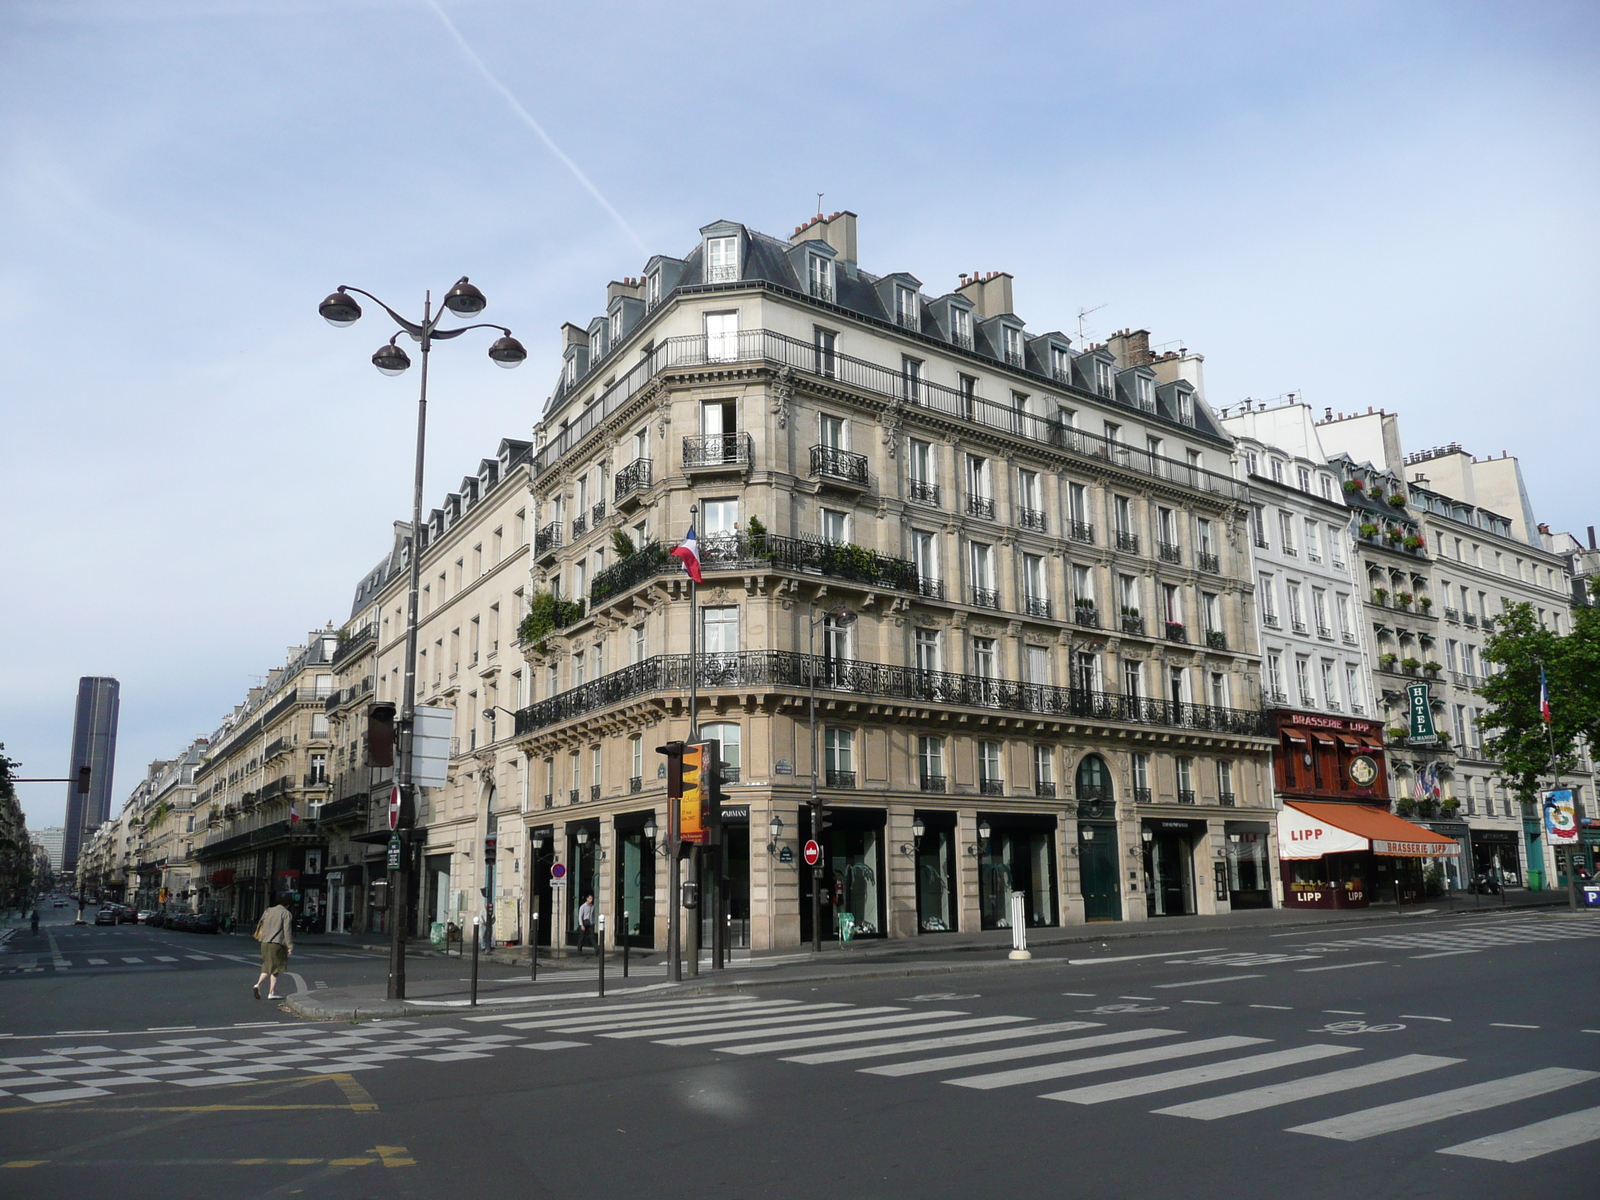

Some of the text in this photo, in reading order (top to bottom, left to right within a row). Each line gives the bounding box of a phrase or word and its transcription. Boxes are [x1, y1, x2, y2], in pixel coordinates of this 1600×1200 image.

[1413, 688, 1426, 733] HOTEL
[1292, 714, 1369, 732] BRASSERIE LIPP
[1291, 829, 1323, 841] LIPP
[1387, 843, 1447, 854] BRASSERIE LIPP
[1297, 892, 1322, 902] LIPP
[1348, 891, 1363, 901] LIPP
[1588, 892, 1597, 902] P
